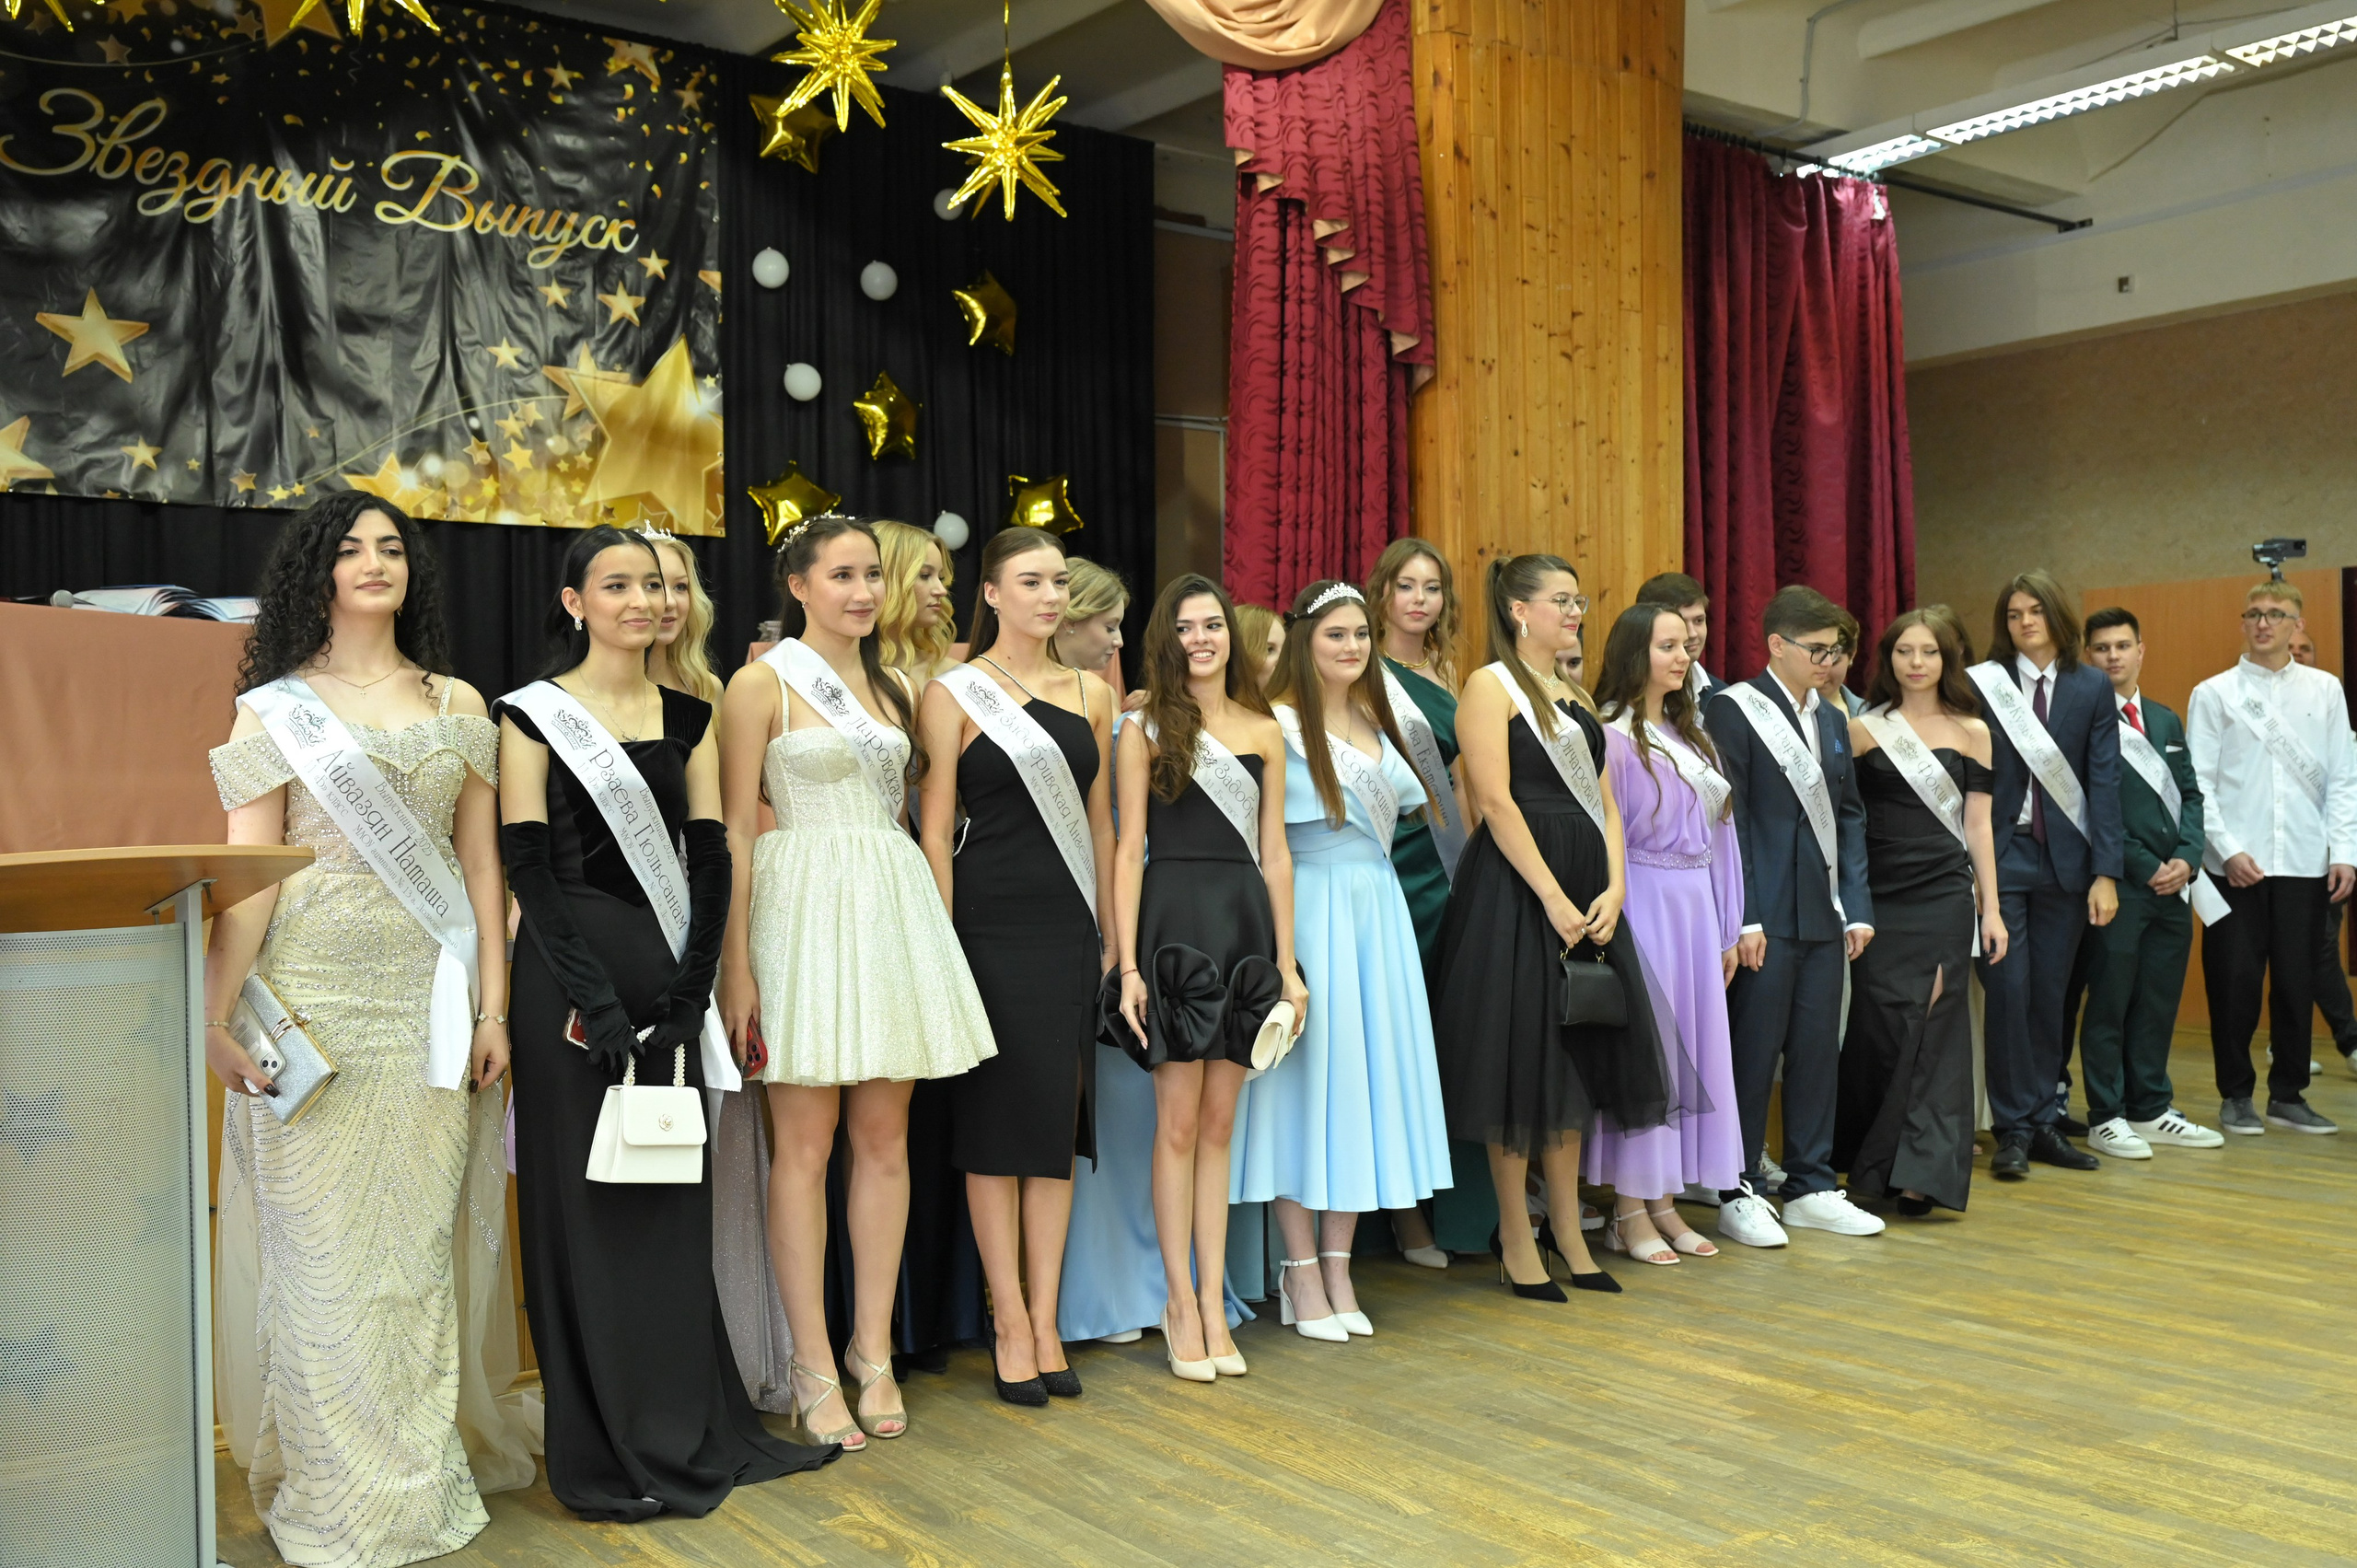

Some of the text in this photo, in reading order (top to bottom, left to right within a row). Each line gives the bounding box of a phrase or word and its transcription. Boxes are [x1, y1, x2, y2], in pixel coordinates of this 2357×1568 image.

[0, 87, 639, 270] Звездный Выпуск
[999, 712, 1072, 820] Задобривская
[1341, 749, 1391, 822] Сорокина
[1773, 723, 1811, 781] Фариди
[1917, 761, 1956, 813] Фокина
[316, 749, 449, 918] Айвазян Наташа
[326, 791, 349, 818] класс
[353, 823, 376, 851] МАОУ
[370, 848, 399, 884] гимназии
[401, 886, 412, 900] 13
[375, 781, 435, 857] Выпускница 2025
[587, 748, 688, 932] Рзаева Гюльсанам
[597, 791, 615, 817] класс
[653, 890, 661, 903] 13
[638, 785, 678, 865] Выпускница 2025
